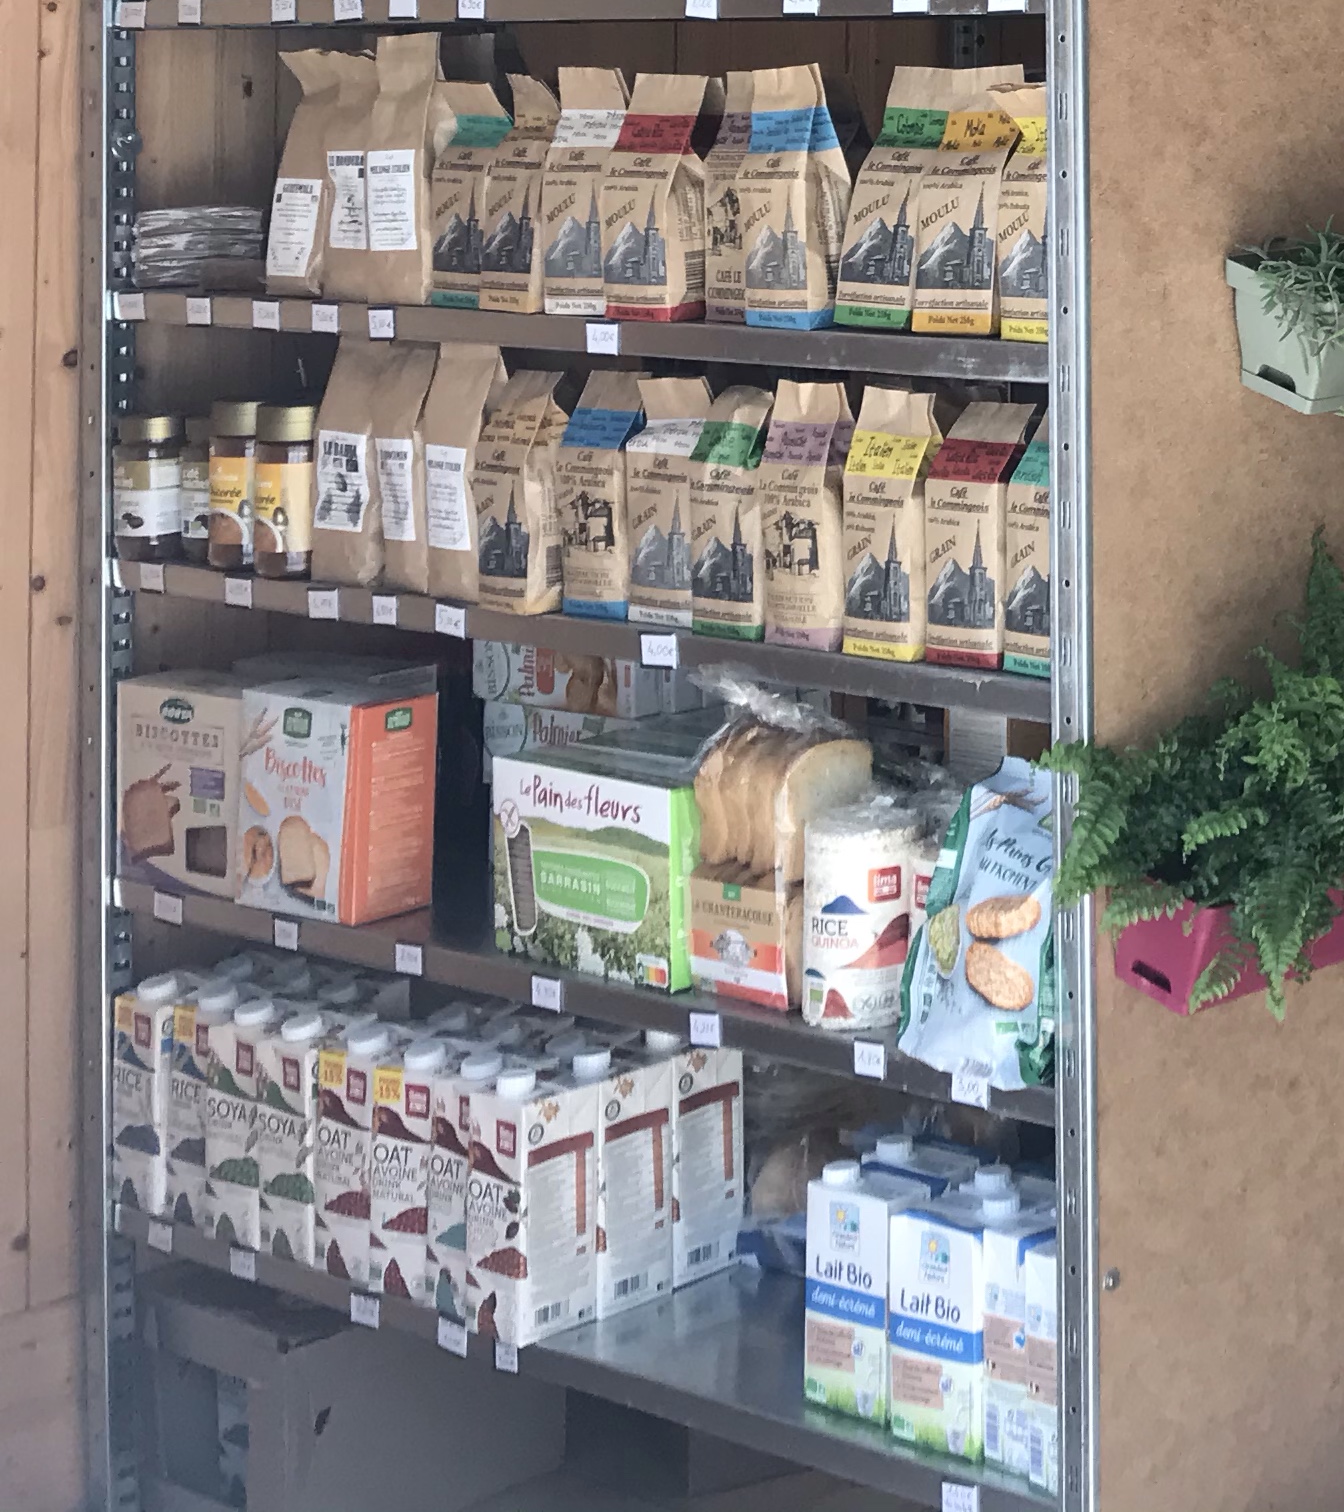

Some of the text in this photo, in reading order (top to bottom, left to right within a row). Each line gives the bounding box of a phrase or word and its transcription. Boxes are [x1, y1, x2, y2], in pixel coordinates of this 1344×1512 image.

[605, 198, 637, 228] MOULU
[853, 193, 891, 225] MOULU
[920, 195, 961, 231] MOULU
[998, 211, 1031, 244] MOULU
[709, 469, 732, 480] Café
[209, 487, 241, 498] hicorée
[937, 498, 990, 513] Commingeois
[950, 487, 969, 499] Café
[847, 534, 872, 561] GRAIN
[929, 535, 957, 564] GRAIN
[647, 641, 674, 658] 4,00€
[135, 723, 220, 749] BISCOTTES
[519, 774, 641, 825] Le Pain des fleurs
[810, 916, 848, 937] RICE
[811, 935, 859, 951] QUINOA
[171, 1078, 201, 1104] RICE
[206, 1096, 247, 1123] SOYA
[258, 1112, 297, 1136] SOYA
[317, 1125, 352, 1151] OAT
[372, 1142, 414, 1167] OAT
[430, 1153, 464, 1177] OAT
[372, 1163, 418, 1182] AVOINE
[468, 1177, 504, 1203] OAT
[815, 1254, 873, 1289] Lait Bio
[900, 1287, 962, 1324] Lait Bio
